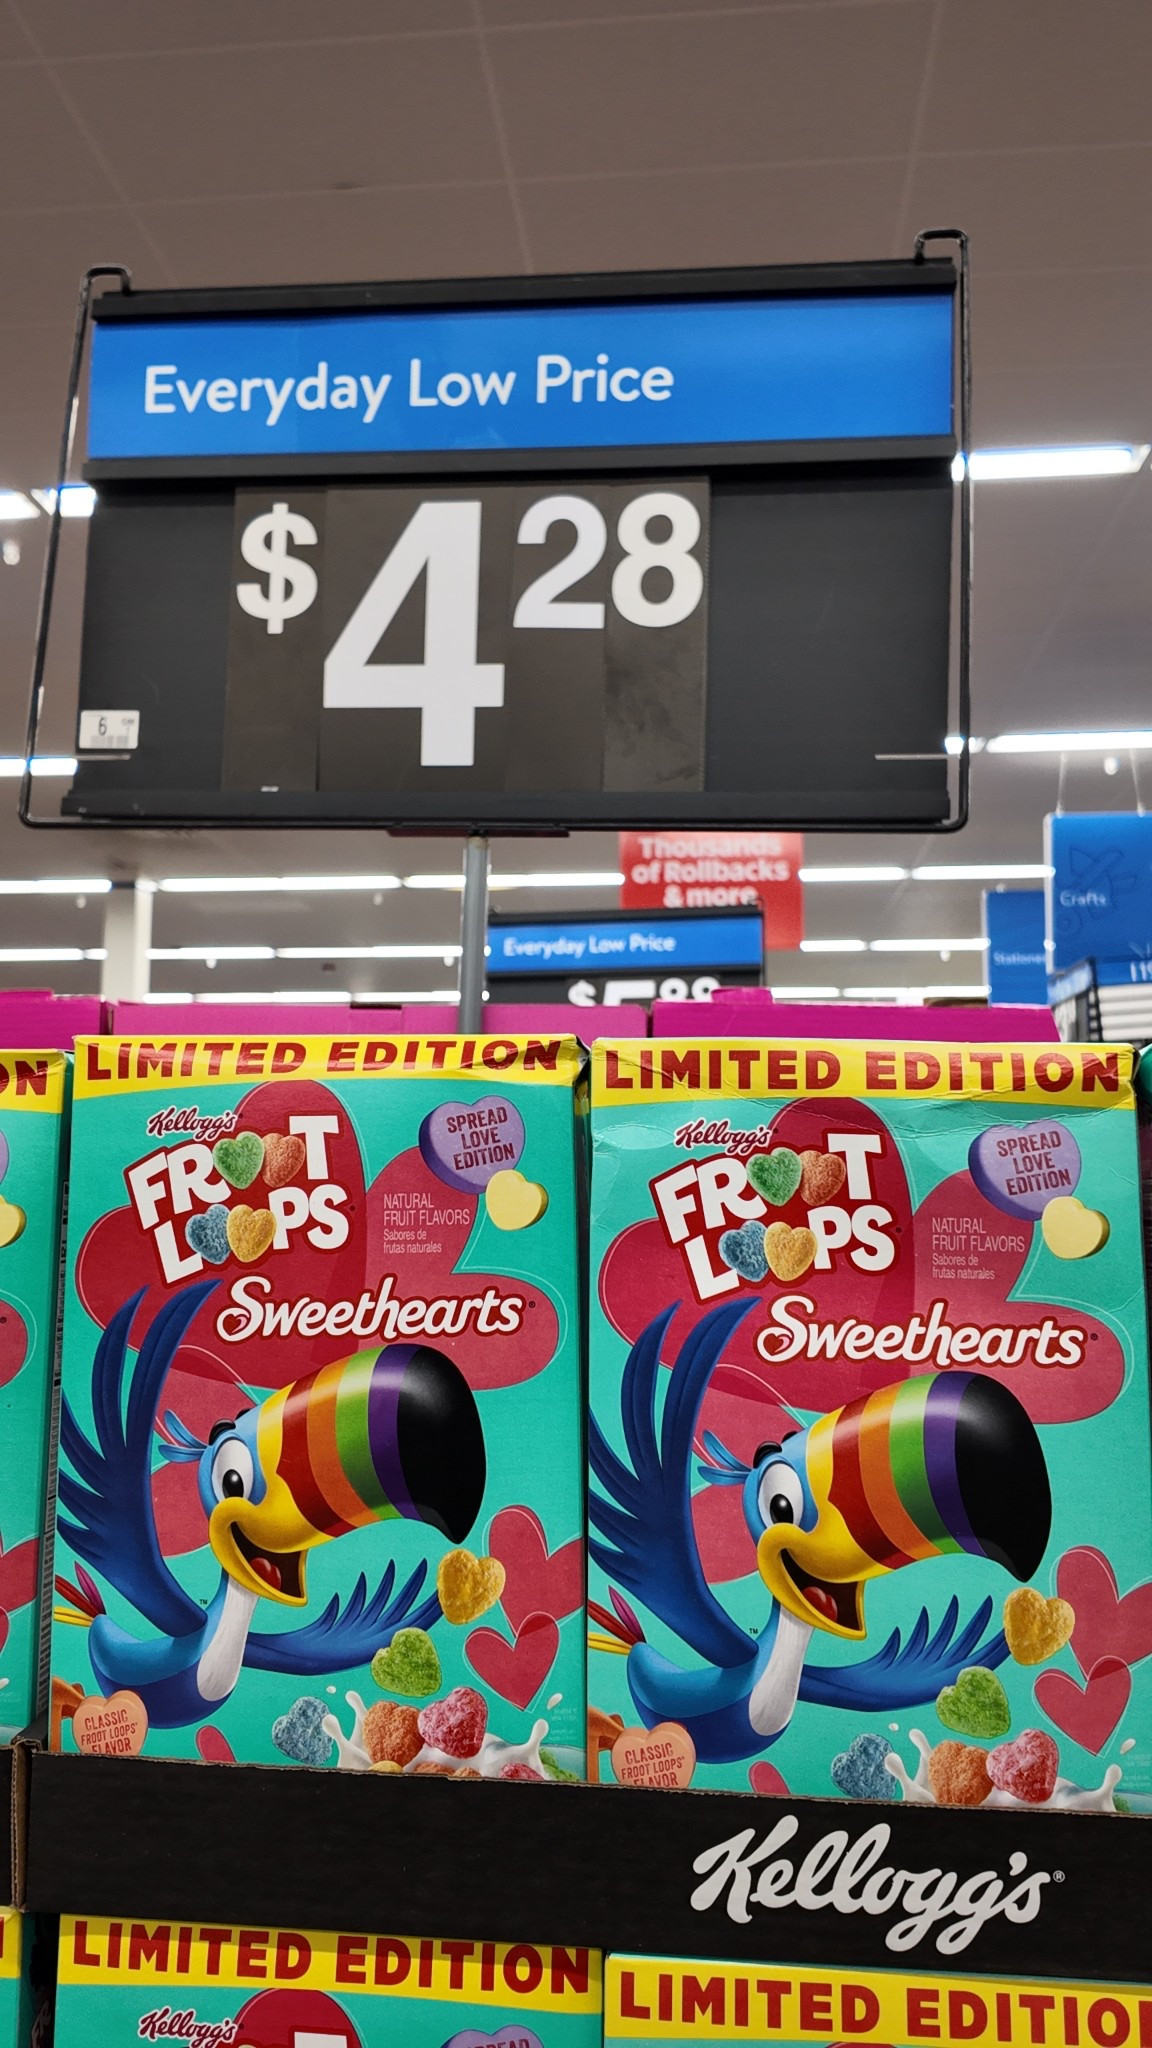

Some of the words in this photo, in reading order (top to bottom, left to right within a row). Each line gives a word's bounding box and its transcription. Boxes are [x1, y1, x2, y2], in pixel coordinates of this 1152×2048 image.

[144, 362, 392, 426] Everyday
[410, 357, 517, 407] Low
[535, 354, 675, 404] Price
[638, 836, 782, 860] Thousands
[631, 861, 661, 884] of
[664, 858, 790, 883] Rollbacks
[663, 884, 684, 908] &
[685, 885, 759, 907] more
[1060, 890, 1107, 907] Crafts
[503, 937, 584, 960] Everyday
[588, 935, 625, 954] Low
[629, 933, 676, 951] Price
[87, 1042, 309, 1082] LIMITED
[326, 1039, 562, 1072] EDITION
[605, 1049, 841, 1091] LIMITED
[866, 1051, 1119, 1093] EDITION
[147, 1106, 238, 1141] Kellogg's
[446, 1106, 508, 1133] SPREAD
[461, 1127, 501, 1149] LOVE
[674, 1118, 772, 1154] Kellogg's
[995, 1130, 1062, 1157] SPREAD
[453, 1142, 516, 1170] EDITION
[1012, 1152, 1056, 1174] LOVE
[1005, 1168, 1072, 1195] EDITION
[383, 1193, 435, 1208] NATURAL
[383, 1210, 416, 1226] FRUIT
[419, 1209, 470, 1225] FLAVORS
[932, 1217, 987, 1234] NATURAL
[383, 1228, 415, 1241] Sabores
[416, 1228, 427, 1240] de
[932, 1234, 967, 1251] FRUIT
[970, 1235, 1025, 1252] FLAVORS
[383, 1242, 405, 1253] frutas
[406, 1242, 442, 1253] naturales
[932, 1253, 966, 1266] Sabores
[968, 1254, 979, 1266] de
[932, 1267, 956, 1279] frutas
[957, 1267, 995, 1280] naturales
[216, 1275, 522, 1342] Sweethearts
[757, 1295, 1084, 1366] Sweethearts
[84, 1708, 128, 1731] CLASSIC
[80, 1729, 107, 1746] FROOT
[624, 1742, 673, 1765] CLASSIC
[621, 1763, 650, 1780] FROOT
[74, 1920, 313, 1980] LIMITED
[335, 1936, 589, 1995] EDITION
[620, 1971, 881, 2033] LIMITED
[139, 2007, 236, 2048] Kellogg's
